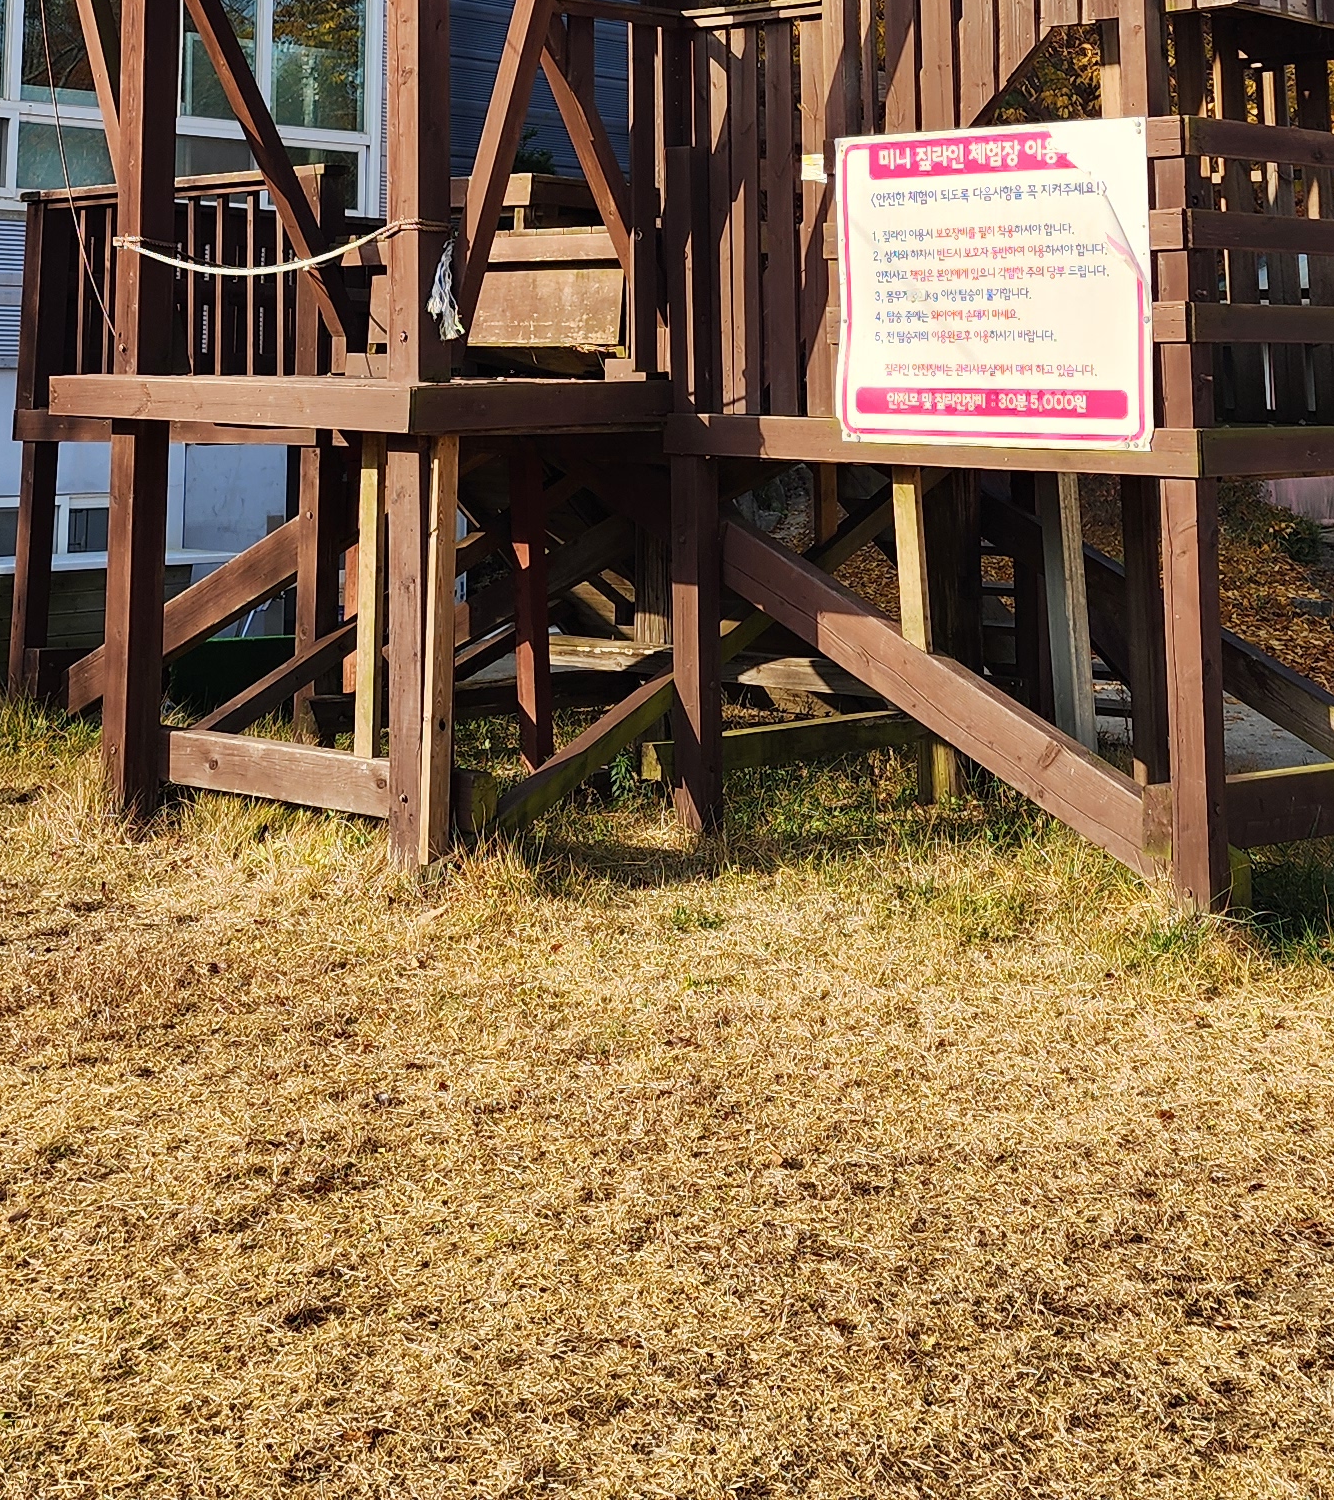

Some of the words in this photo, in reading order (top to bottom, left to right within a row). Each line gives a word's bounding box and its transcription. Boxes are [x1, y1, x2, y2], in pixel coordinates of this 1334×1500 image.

[878, 148, 911, 169] 미니
[915, 145, 965, 171] 짚라인
[968, 140, 1021, 168] 체험장
[908, 189, 938, 205] 체험이
[941, 187, 970, 203] 되도록
[972, 185, 1023, 201] 다음사항을
[882, 230, 907, 242] 짚라인
[909, 229, 933, 241] 이용시
[935, 227, 976, 239] 보호장비를
[978, 226, 995, 238] 필히
[998, 224, 1041, 238] 착용하셔야
[1044, 223, 1074, 236] 합니다.
[937, 246, 962, 260] 반드시
[964, 246, 989, 259] 보호자
[991, 245, 1025, 258] 동반하여
[1027, 244, 1074, 257] 이용하셔야
[1076, 243, 1108, 257] 합니다.
[875, 270, 908, 283] 안전사고
[910, 269, 934, 281] 책임은
[937, 268, 968, 280] 본인에게
[971, 268, 996, 279] 있으니
[998, 267, 1025, 280] 각별한
[1026, 266, 1044, 278] 주의
[1047, 266, 1065, 279] 당부
[1068, 265, 1110, 278] 드립니다.
[941, 288, 957, 301] 이상
[959, 288, 983, 301] 탑승이
[986, 288, 1032, 301] 불가합니다.
[887, 310, 902, 323] 탑승
[905, 310, 929, 323] 중에는
[931, 310, 963, 322] 와이어에
[992, 309, 1020, 320] 마세요.
[897, 331, 929, 342] 탑승자의
[931, 331, 972, 342] 이용완료후
[974, 330, 1015, 342] 이용하시기
[1017, 330, 1057, 342] 바랍니다.
[884, 363, 910, 376] 짚라인
[912, 363, 953, 377] 안전장비는
[955, 363, 1013, 377] 관리사무실에서
[1016, 364, 1033, 376] 대여
[1036, 364, 1054, 376] 하고
[1056, 364, 1098, 377] 있습니다.
[887, 392, 919, 410] 안전모
[998, 394, 1028, 411] 30분
[1030, 394, 1087, 413] 5,000원
